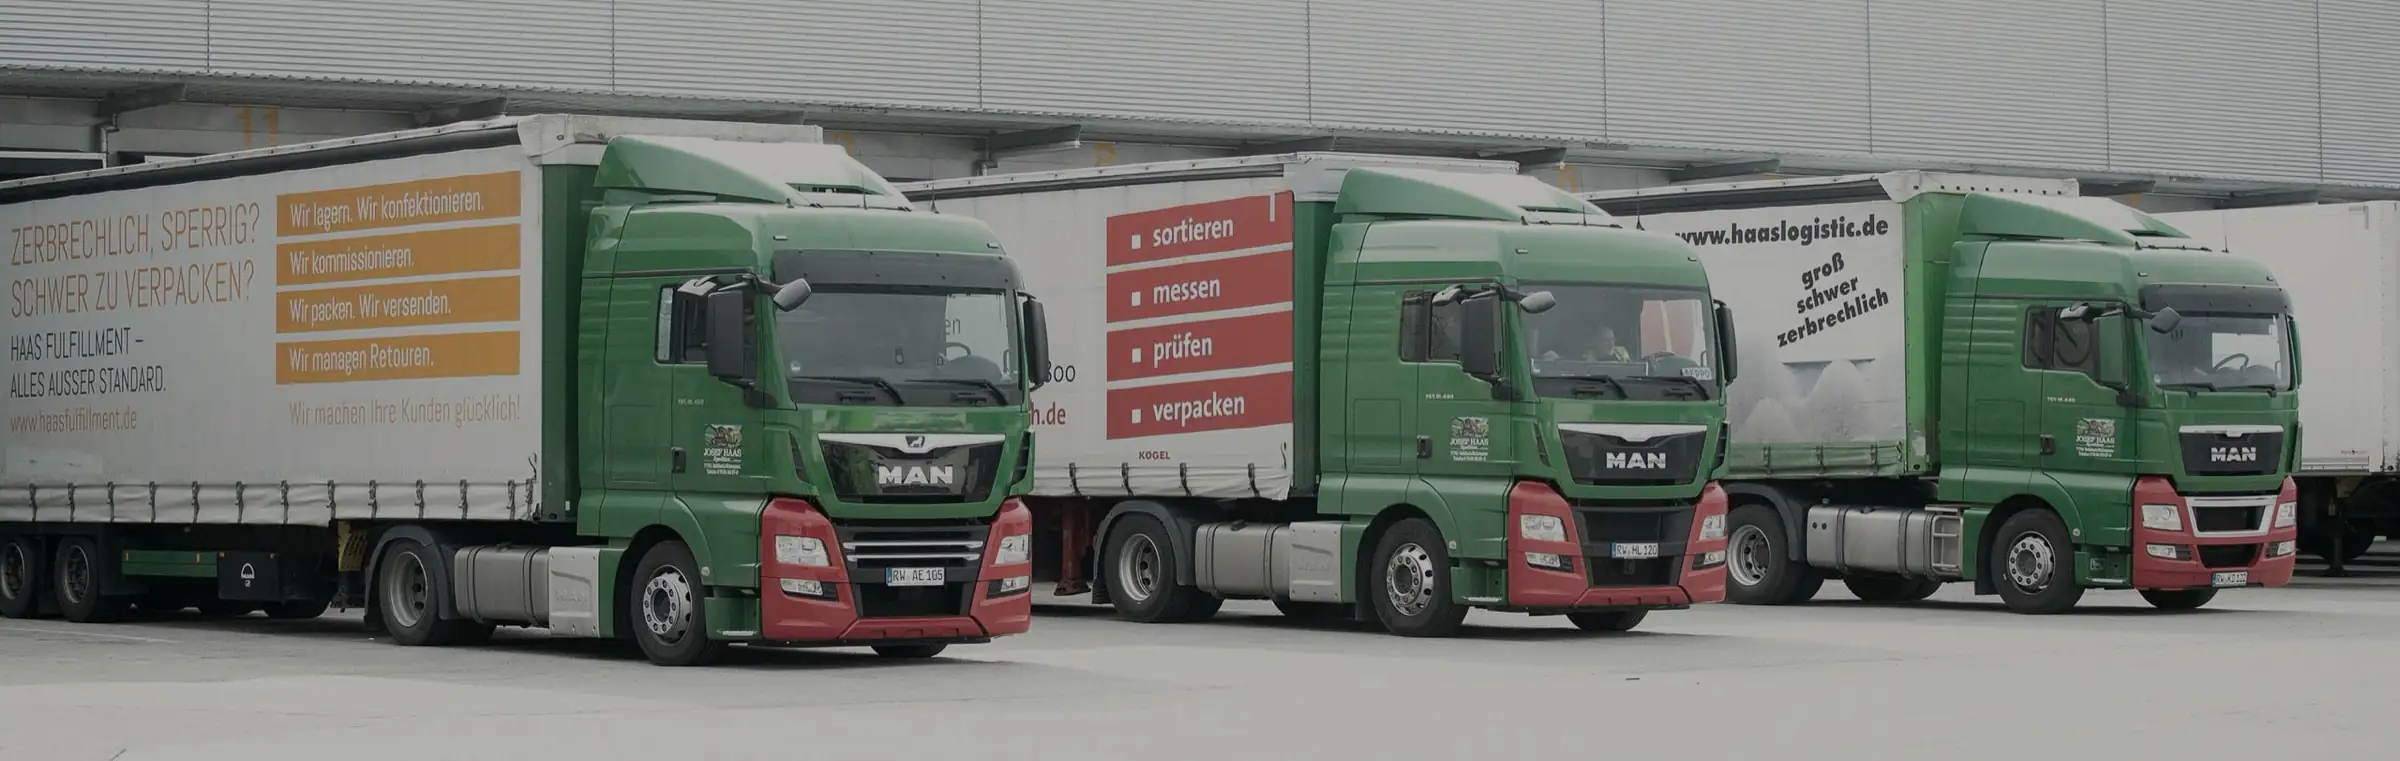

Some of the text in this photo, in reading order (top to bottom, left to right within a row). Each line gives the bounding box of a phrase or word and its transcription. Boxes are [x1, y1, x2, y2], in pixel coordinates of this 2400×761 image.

[234, 103, 279, 149] 11
[290, 189, 484, 232] Wir lagern. Wir konfektionieren.
[11, 202, 260, 266] ZERBRECHLICH, SPERRIG?
[1152, 216, 1234, 247] sortieren
[1675, 214, 1889, 246] www.haaslogistic.de
[290, 245, 415, 275] Wir kommissionieren.
[1801, 252, 1845, 290] groß
[11, 259, 255, 318] SCHWER ZU VERPACKEN?
[1153, 278, 1221, 304] messen
[1796, 276, 1858, 314] schwer
[289, 289, 452, 327] Wir packen. Wir versenden.
[1777, 288, 1889, 348] zerbrechlich
[11, 333, 42, 361] HAAS
[46, 327, 131, 359] FULFILLMENT
[289, 343, 434, 376] Wir managen Retouren.
[1153, 331, 1213, 368] prüfen
[10, 365, 166, 398] ALLES AUSSER STANDARD.
[10, 406, 137, 433] www.haasfulfillment.de
[289, 394, 520, 429] Wir machen Ihre Kunden glücklich!
[1152, 391, 1245, 427] verpacken
[723, 448, 742, 457] HAAS
[1606, 452, 1666, 469] MAN
[2211, 447, 2256, 462] MAN
[878, 465, 953, 484] MAN
[893, 569, 906, 581] RW
